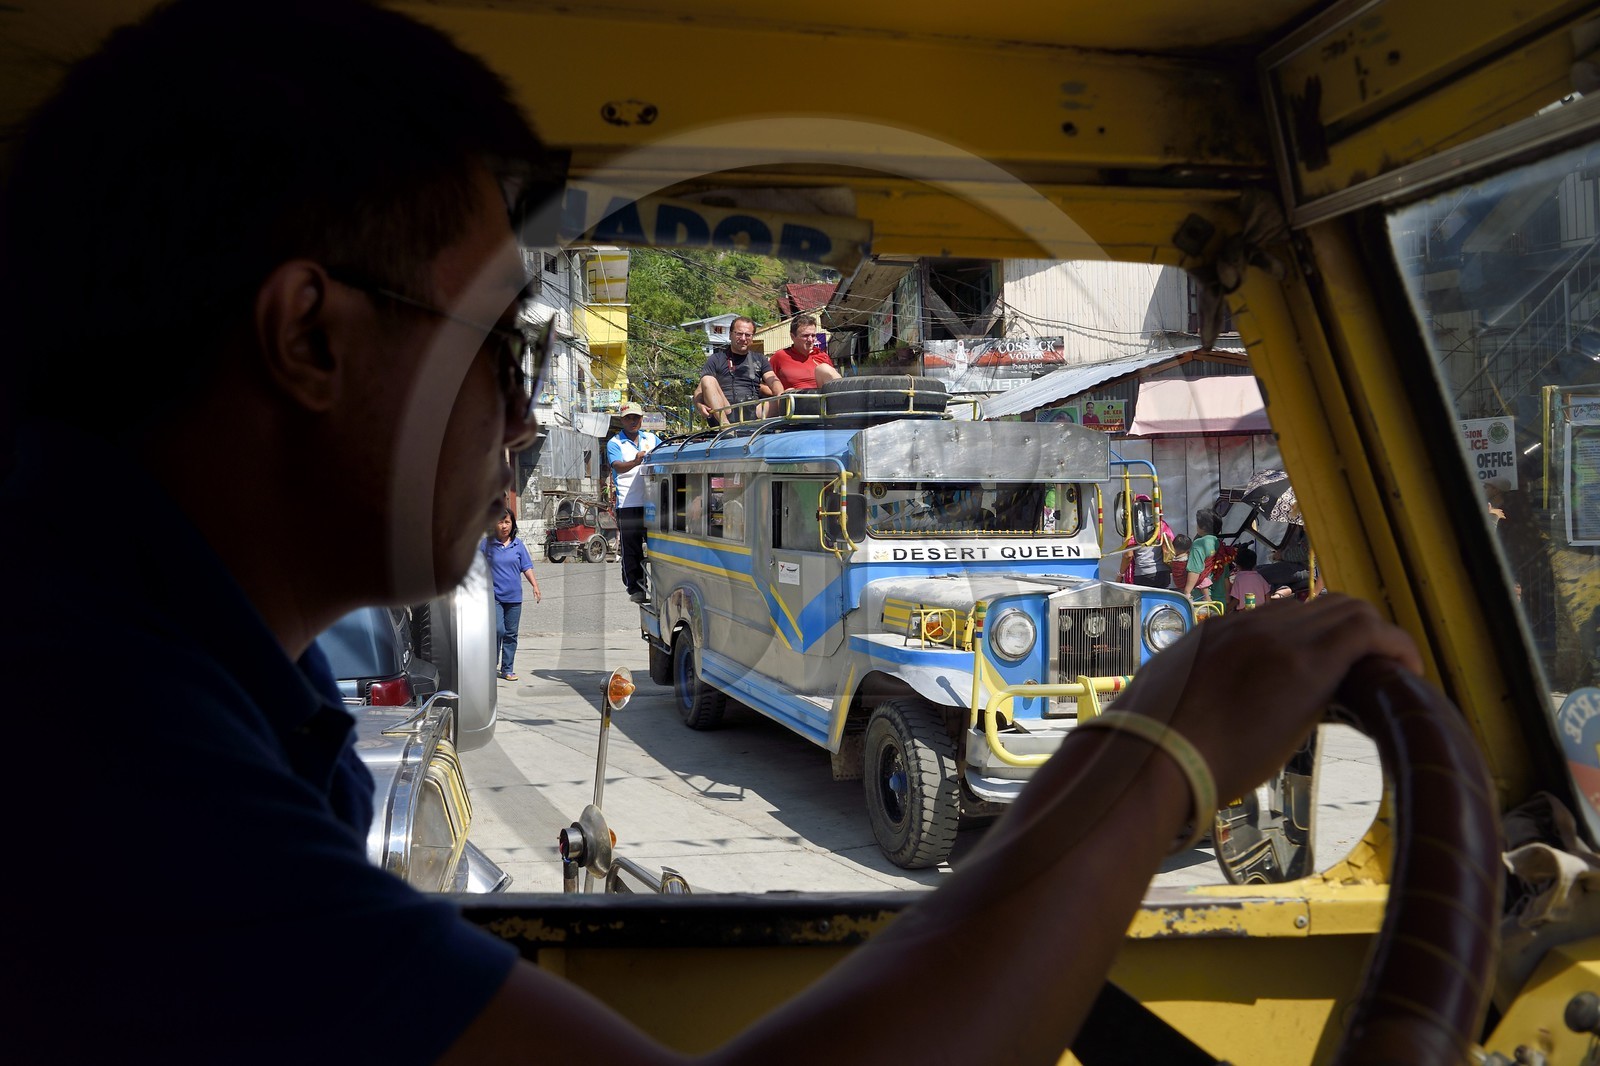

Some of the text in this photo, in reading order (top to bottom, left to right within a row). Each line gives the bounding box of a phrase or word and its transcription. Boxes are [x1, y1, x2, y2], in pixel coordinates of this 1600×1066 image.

[1476, 451, 1514, 468] OFFICE
[893, 545, 1081, 561] DESERT QUEEN
